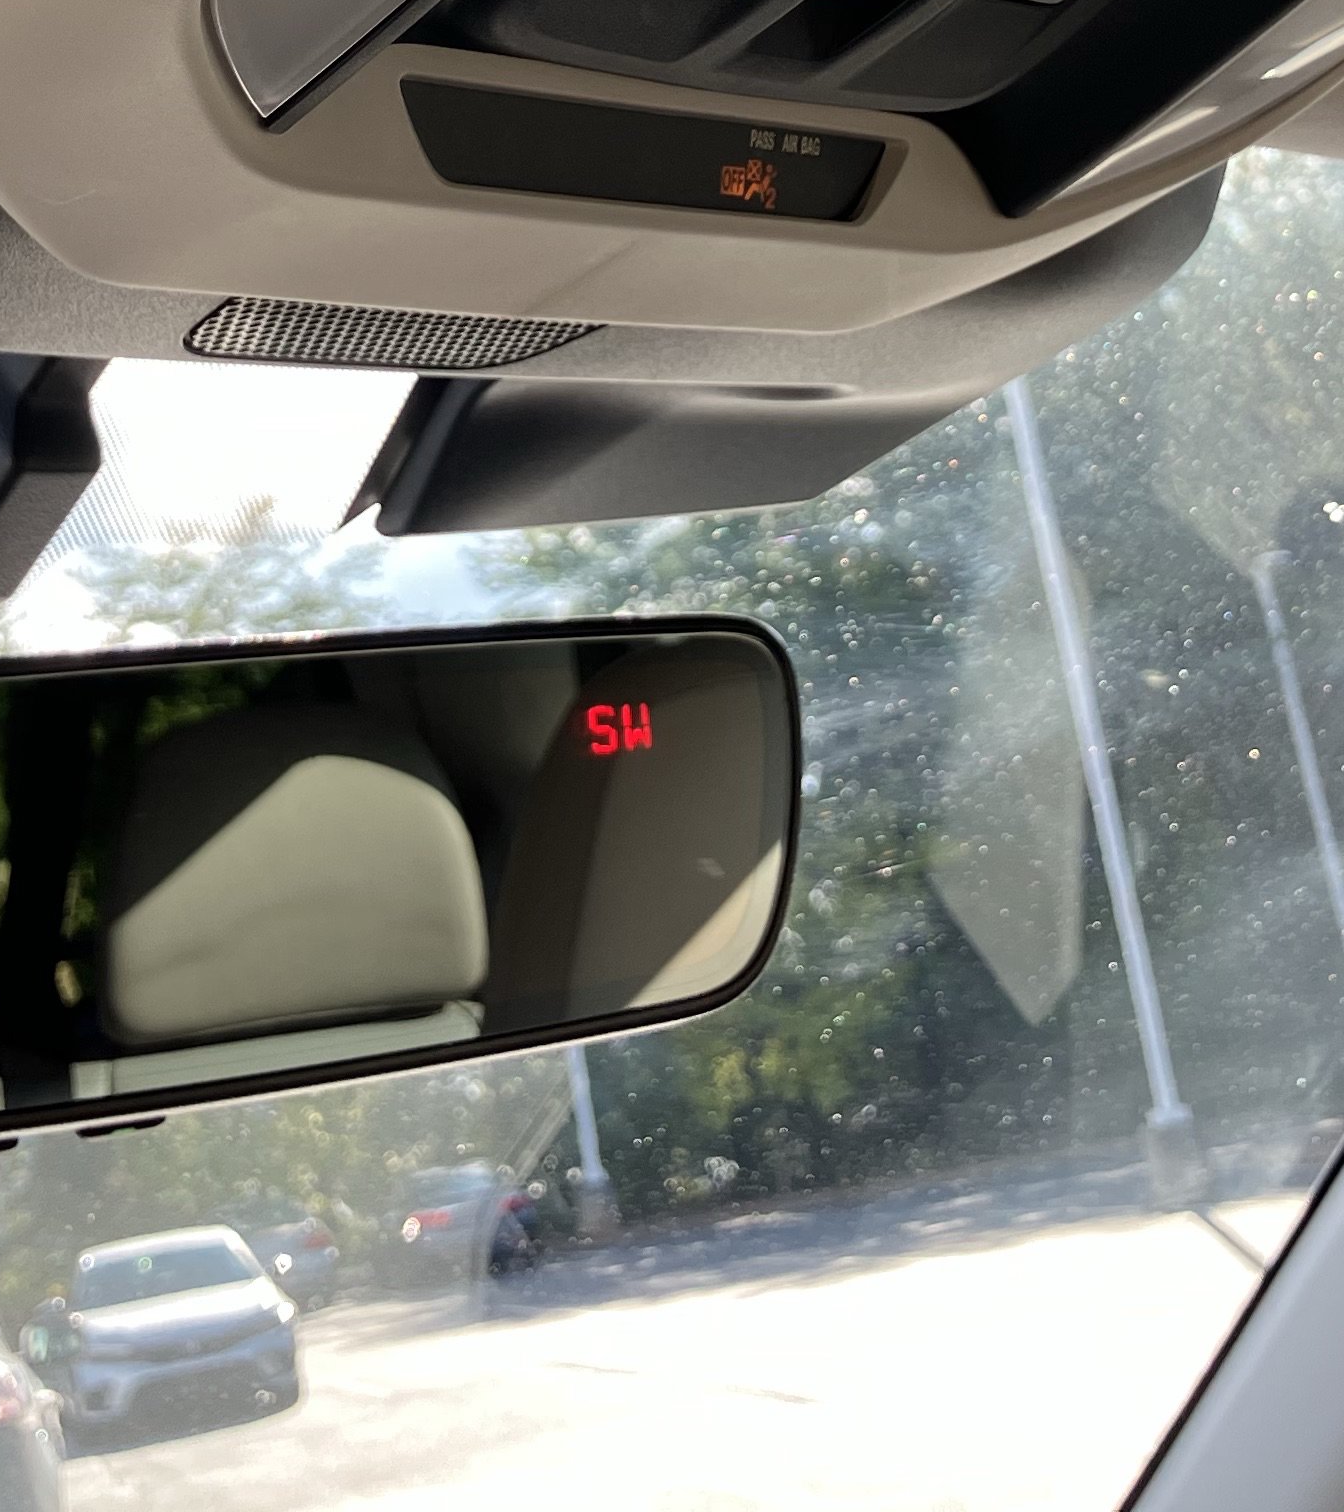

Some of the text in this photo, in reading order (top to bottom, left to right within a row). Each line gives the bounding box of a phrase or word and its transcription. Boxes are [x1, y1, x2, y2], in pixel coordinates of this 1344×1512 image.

[749, 129, 821, 157] PASS AIR BAG
[586, 702, 654, 756] SW
